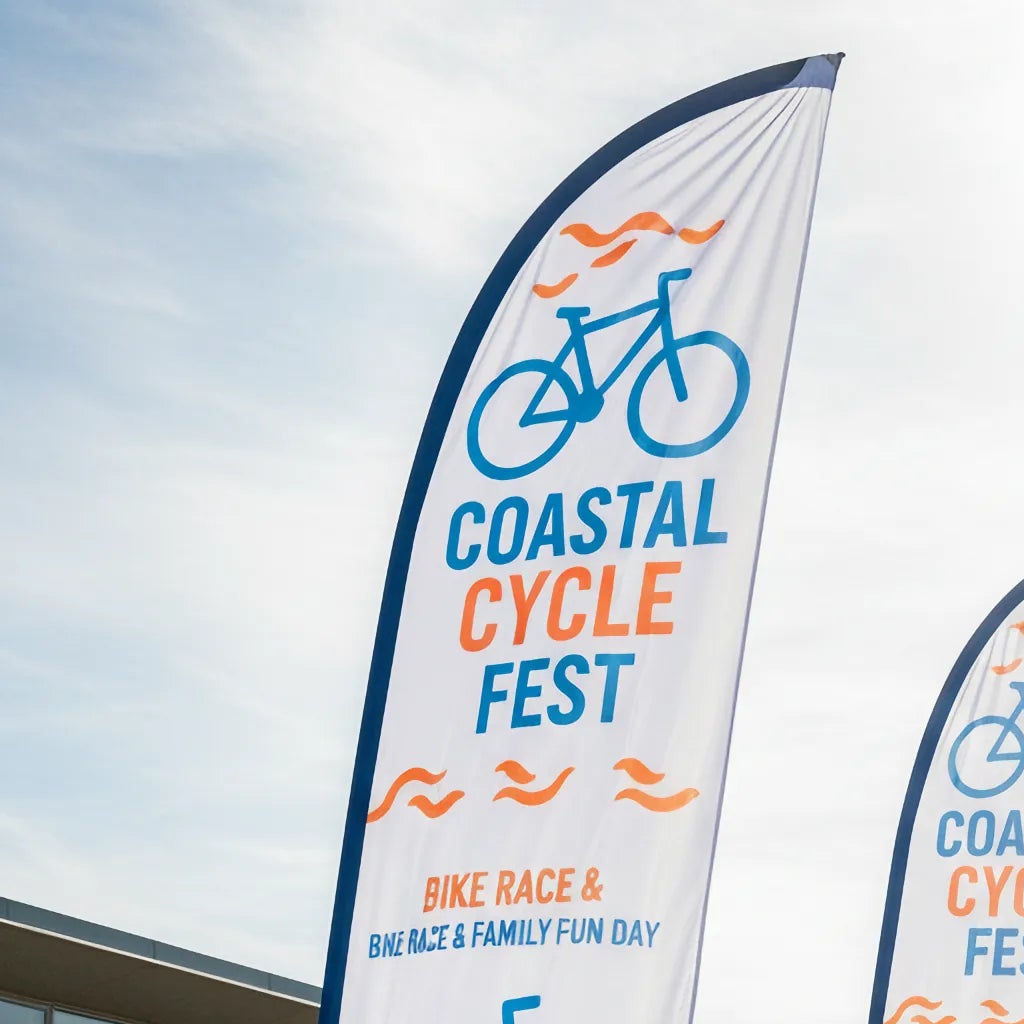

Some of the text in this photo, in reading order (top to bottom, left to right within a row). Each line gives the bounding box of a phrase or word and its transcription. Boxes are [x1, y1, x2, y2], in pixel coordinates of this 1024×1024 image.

[445, 478, 728, 570] COASTAL
[458, 561, 682, 652] CYCLE
[475, 653, 635, 735] FEST
[423, 866, 604, 913] BIKE RACE &
[452, 923, 465, 948] &
[471, 918, 552, 948] FAMILY
[557, 917, 604, 944] FUN
[612, 919, 660, 948] DAY
